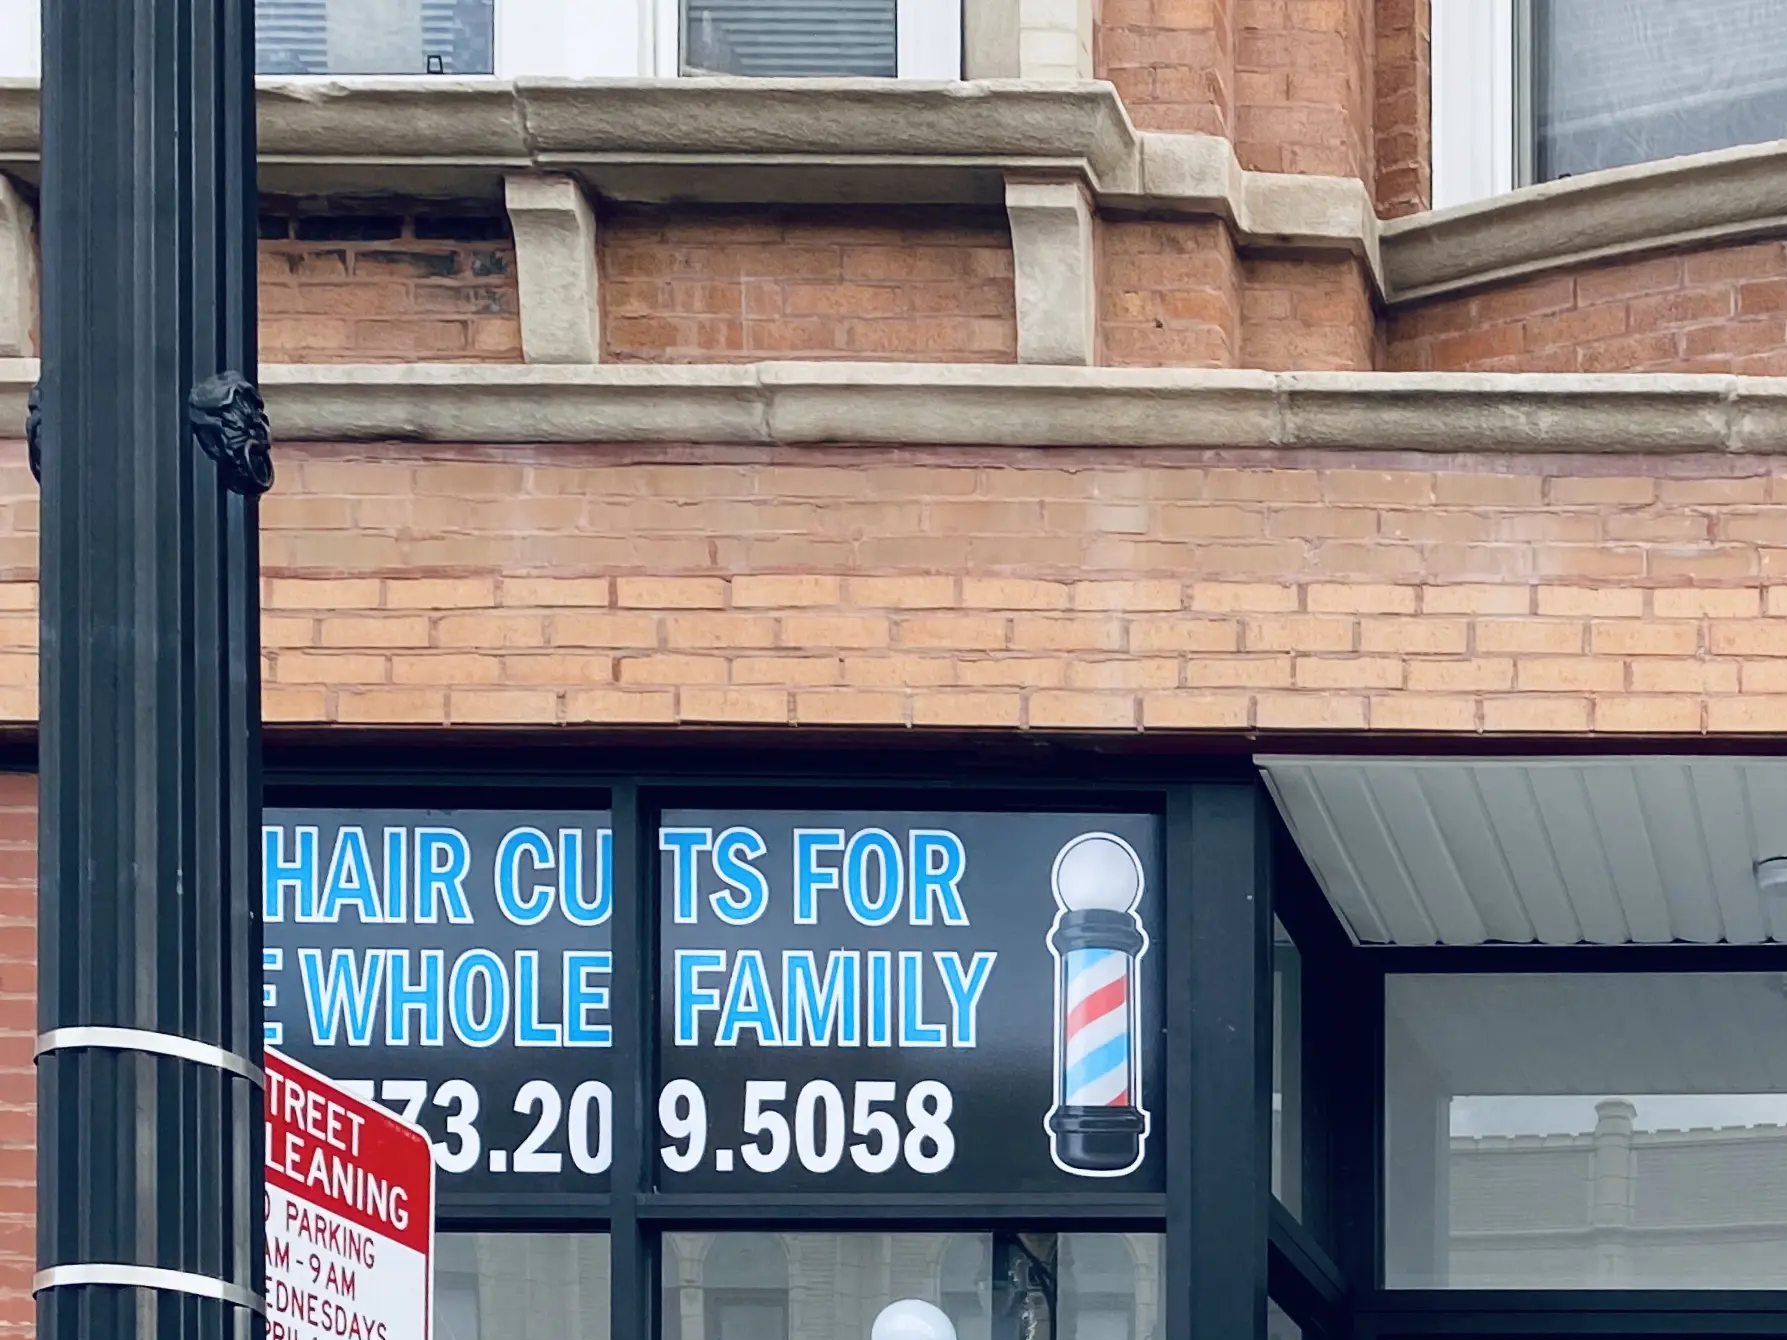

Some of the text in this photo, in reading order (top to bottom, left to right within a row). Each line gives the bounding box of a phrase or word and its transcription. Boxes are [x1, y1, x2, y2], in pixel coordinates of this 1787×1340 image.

[263, 826, 474, 926] HAIR
[793, 828, 970, 926] FOR
[297, 948, 612, 1047] WHOLE
[674, 947, 998, 1048] FAMILY
[265, 1067, 365, 1157] TREET
[265, 1121, 409, 1230] LEANING
[286, 1200, 375, 1269] PARKING
